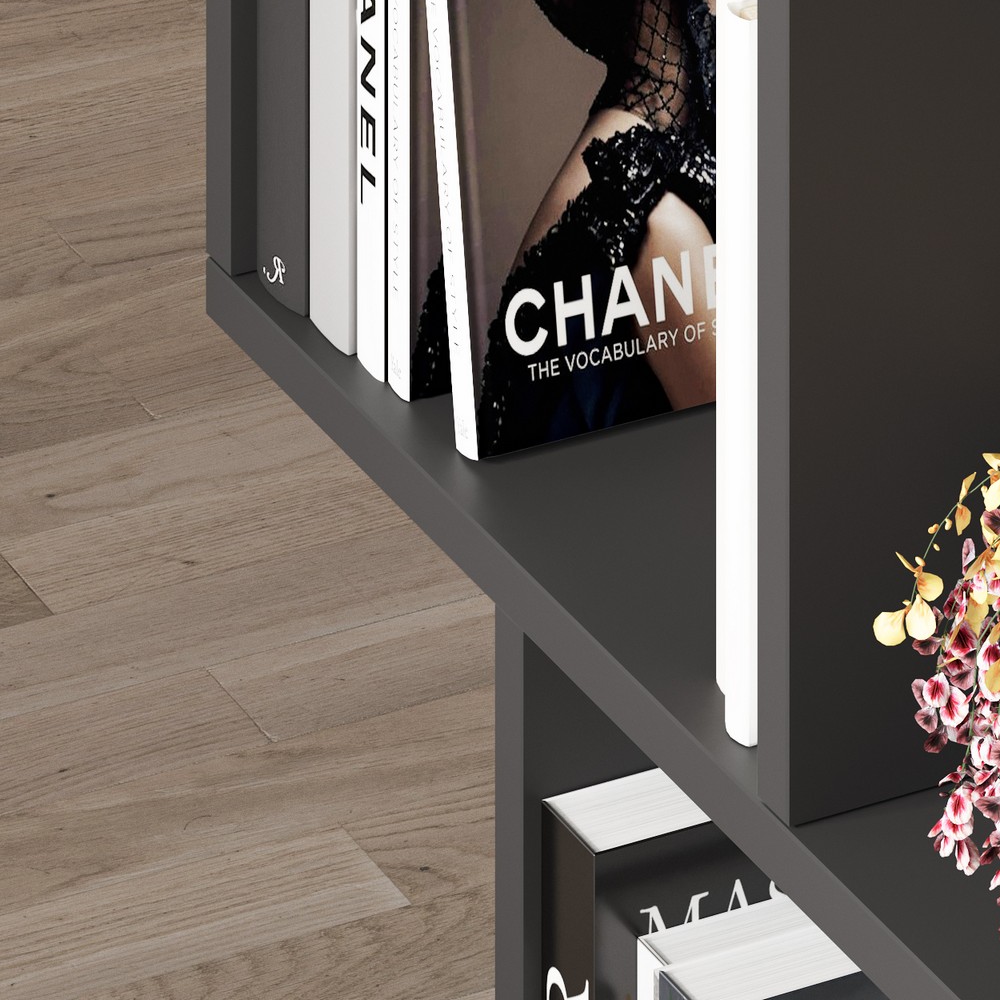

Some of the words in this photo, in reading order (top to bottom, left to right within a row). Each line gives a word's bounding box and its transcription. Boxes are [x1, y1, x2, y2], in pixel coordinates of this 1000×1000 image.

[527, 357, 561, 382] THE
[564, 328, 678, 373] VOCABULARY
[683, 321, 706, 343] OF
